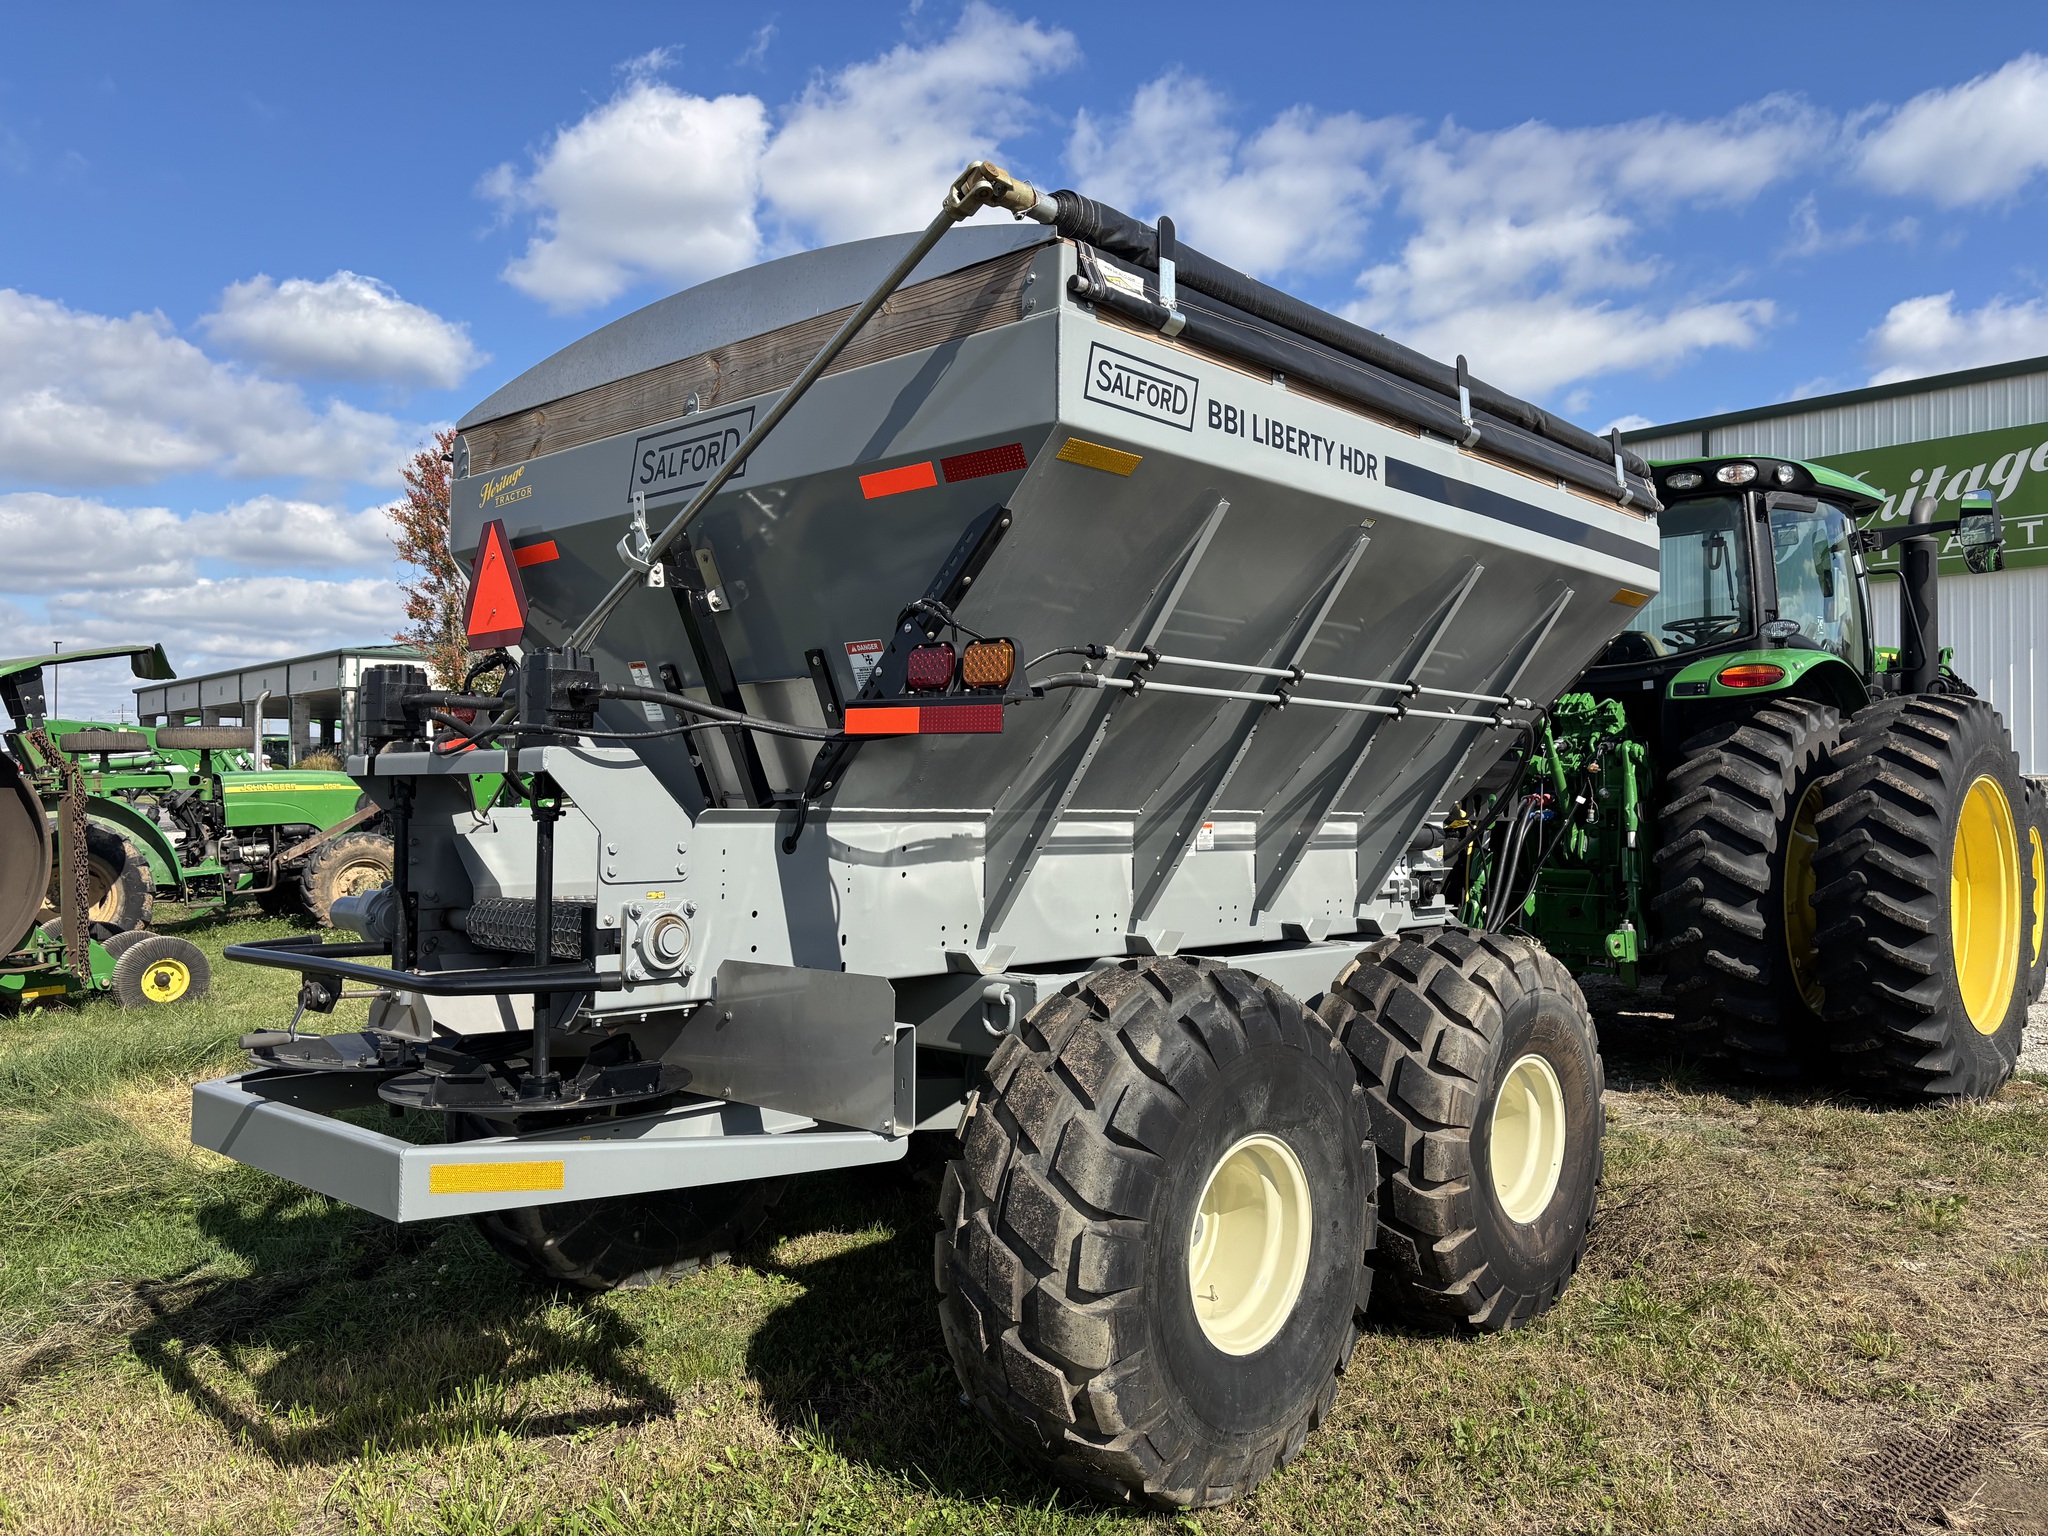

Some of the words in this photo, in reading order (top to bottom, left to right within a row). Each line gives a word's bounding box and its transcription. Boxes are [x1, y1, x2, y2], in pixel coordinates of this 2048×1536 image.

[1096, 359, 1188, 415] SALFORD
[1208, 398, 1245, 438] BBI
[1252, 413, 1335, 466] LIBERTY
[1340, 444, 1378, 481] HDR
[479, 465, 525, 508] Heritage
[495, 487, 532, 505] TRACTOR
[856, 643, 878, 651] DANGER
